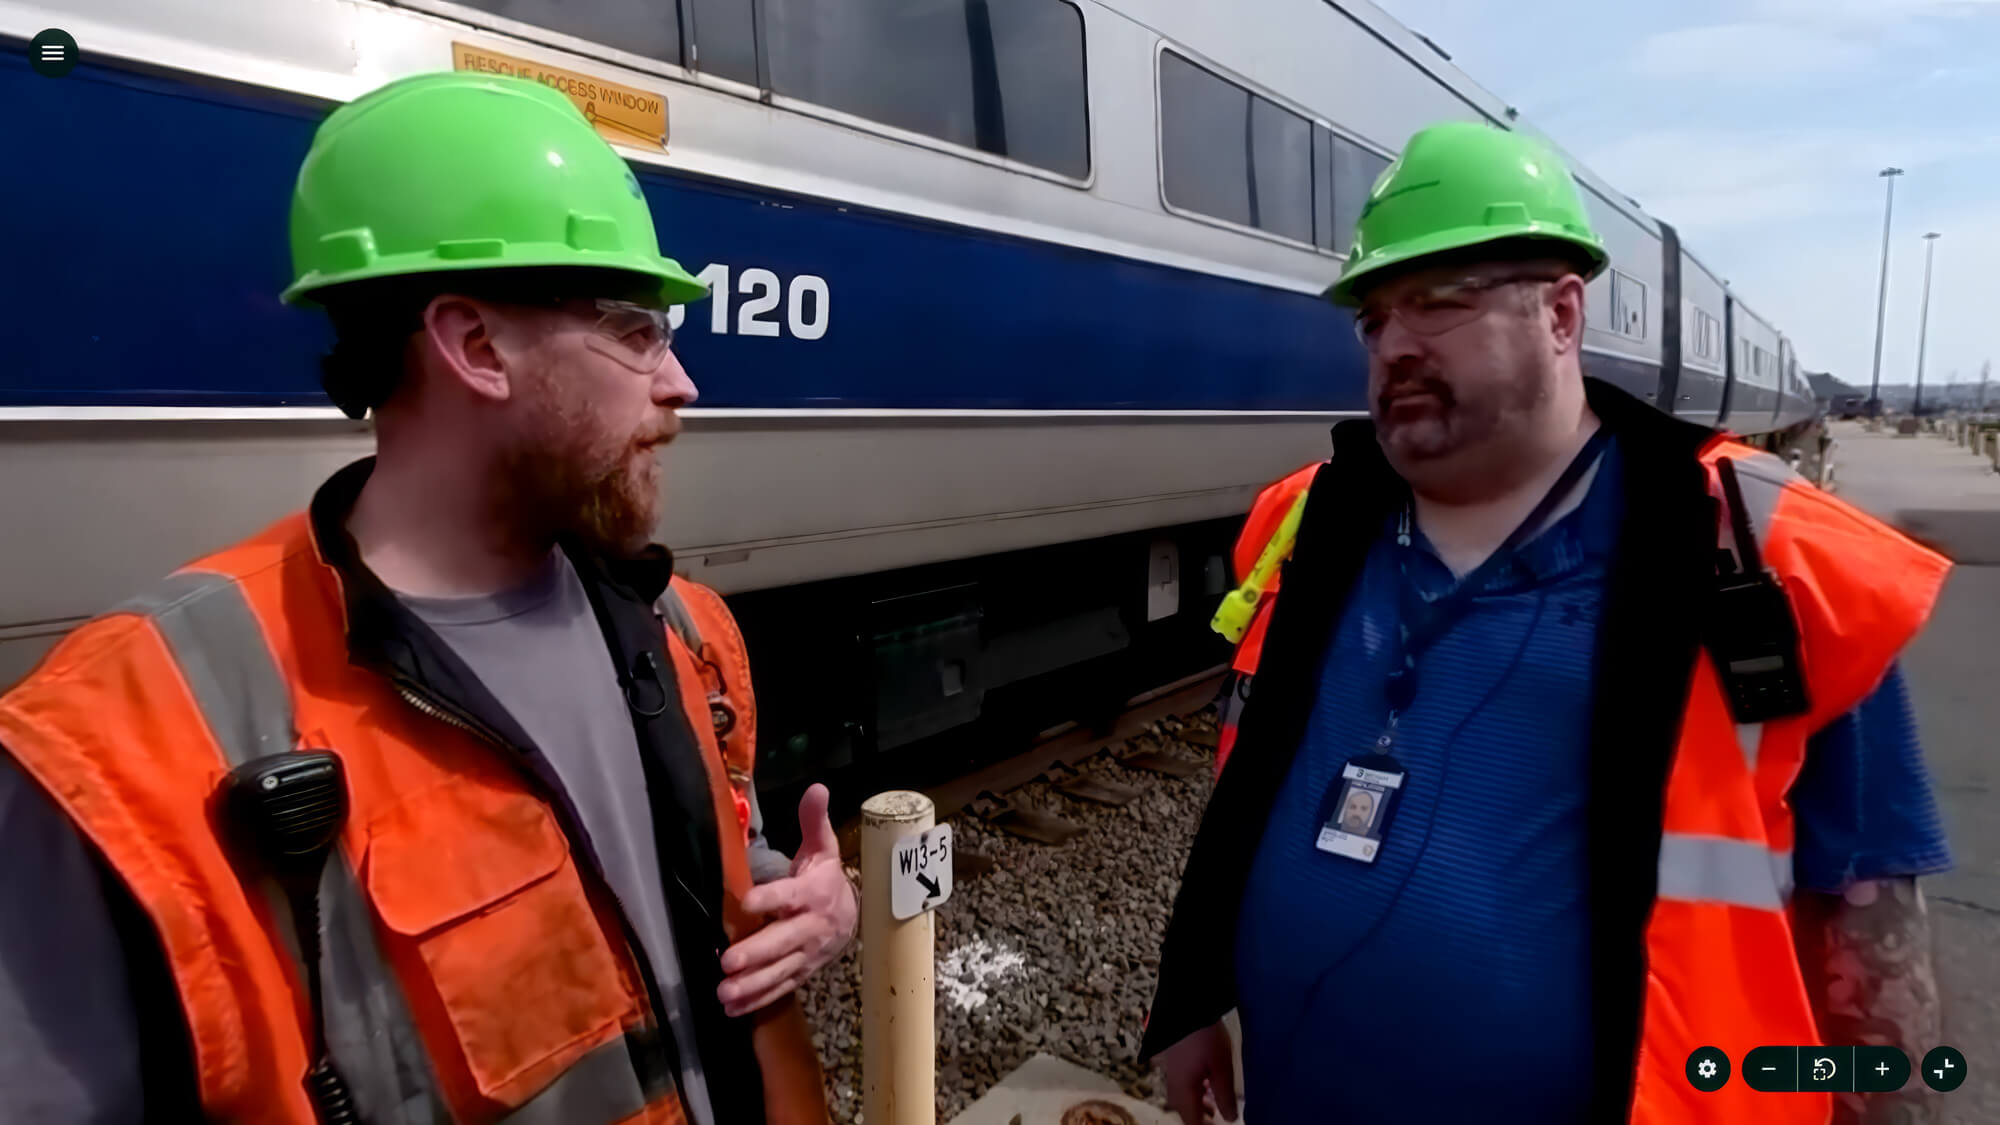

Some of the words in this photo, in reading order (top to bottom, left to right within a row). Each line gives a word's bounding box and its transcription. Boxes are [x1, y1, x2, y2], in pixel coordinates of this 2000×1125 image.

[536, 71, 597, 100] ACCESS
[599, 87, 659, 114] WINDOW
[669, 263, 830, 340] 120
[899, 835, 948, 876] W13-5
